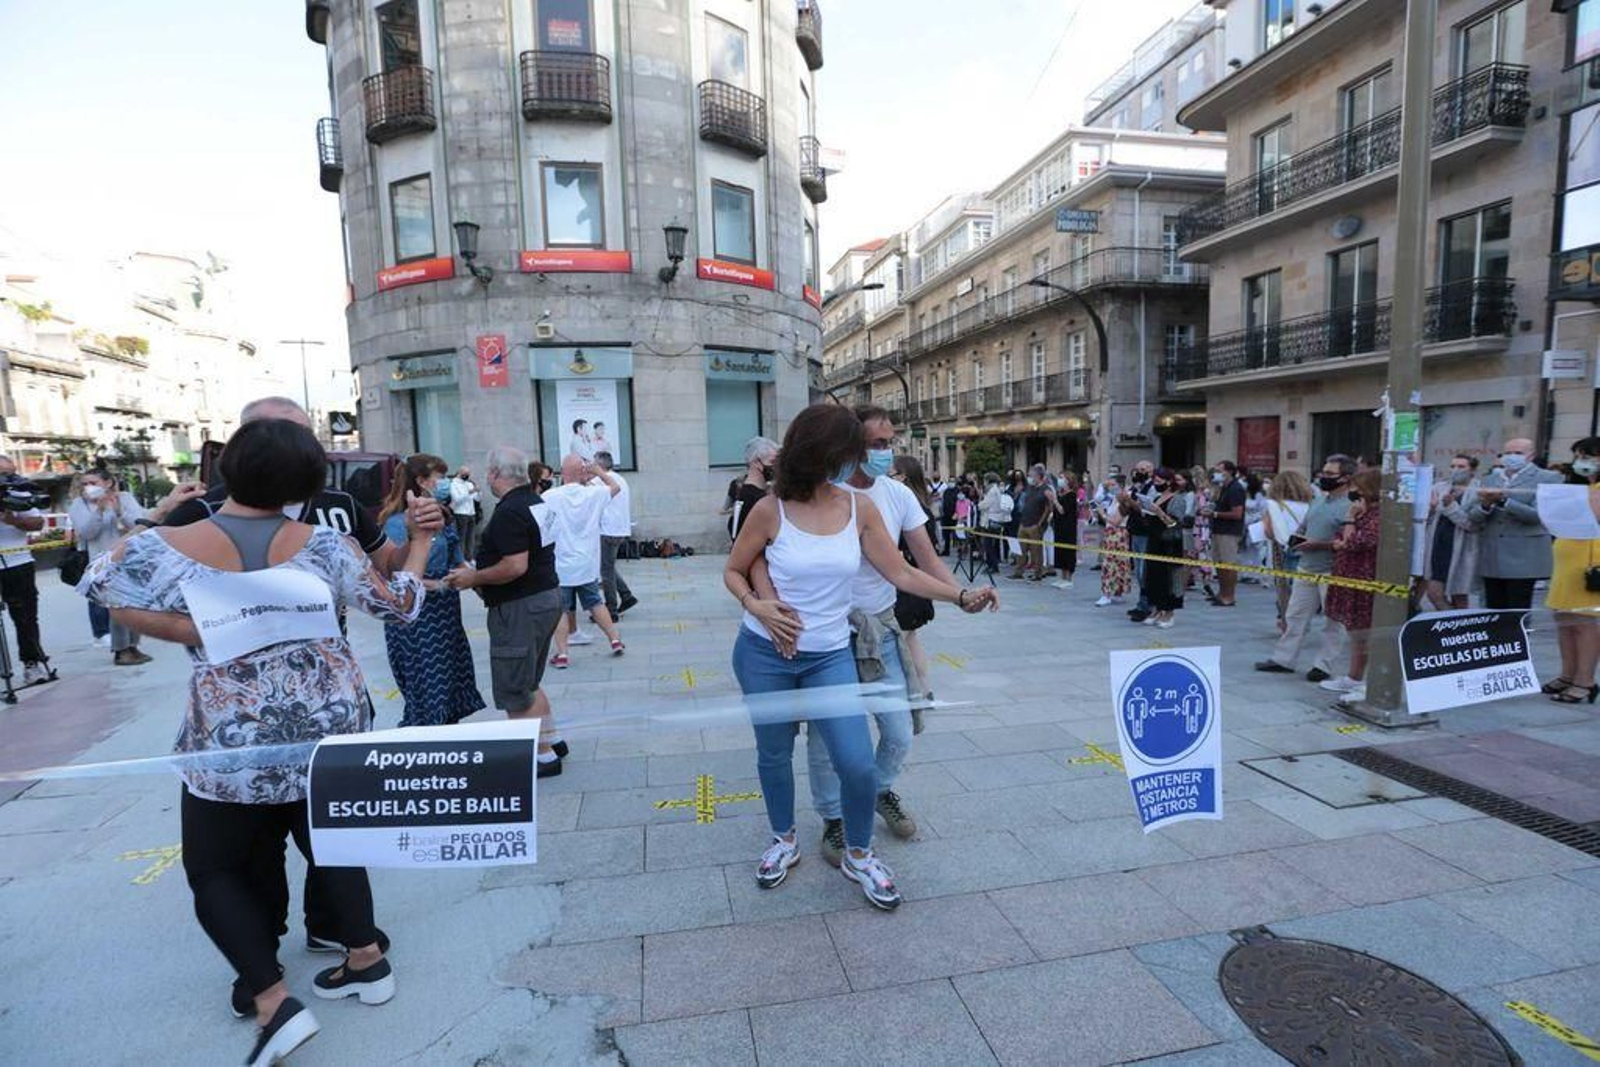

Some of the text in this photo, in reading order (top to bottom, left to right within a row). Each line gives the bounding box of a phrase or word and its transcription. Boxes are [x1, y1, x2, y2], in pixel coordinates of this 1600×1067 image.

[724, 359, 771, 374] Santander
[1431, 614, 1500, 632] Apoyamos a
[1441, 630, 1489, 647] nuestras
[1413, 641, 1522, 671] ESCUELAS DE BAILE
[1154, 688, 1177, 700] 2 m
[364, 749, 484, 770] Apoyamos a
[384, 775, 468, 791] nuestras
[1136, 771, 1202, 793] MANTENER
[1139, 785, 1199, 807] DISTANCIA
[328, 796, 521, 818] ESCUELAS DE BAILE
[1143, 797, 1198, 821] 2 METROS
